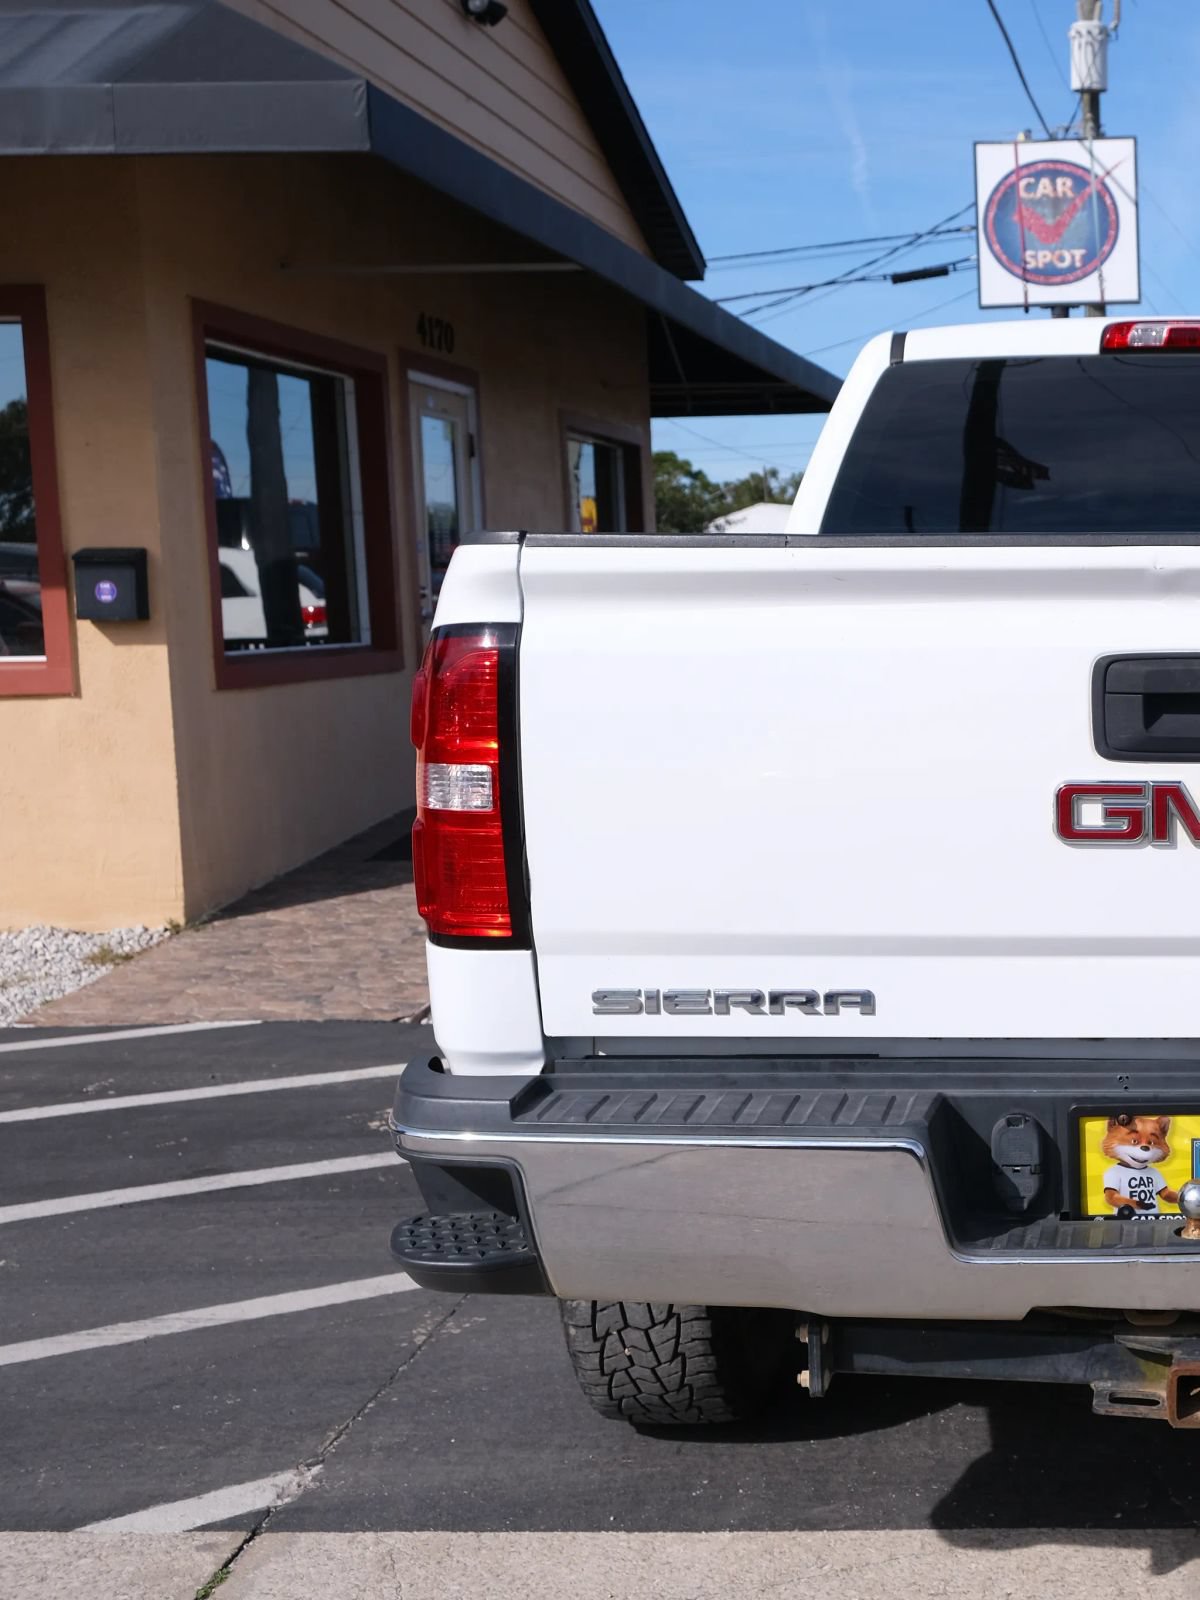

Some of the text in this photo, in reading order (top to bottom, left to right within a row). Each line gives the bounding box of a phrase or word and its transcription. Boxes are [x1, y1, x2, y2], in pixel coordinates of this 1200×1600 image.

[1019, 177, 1075, 198] CAR
[1024, 249, 1086, 269] SPOT
[417, 312, 455, 354] 4170
[591, 988, 876, 1016] SIERRA
[1128, 1177, 1154, 1189] CAR
[1129, 1190, 1156, 1202] FOX
